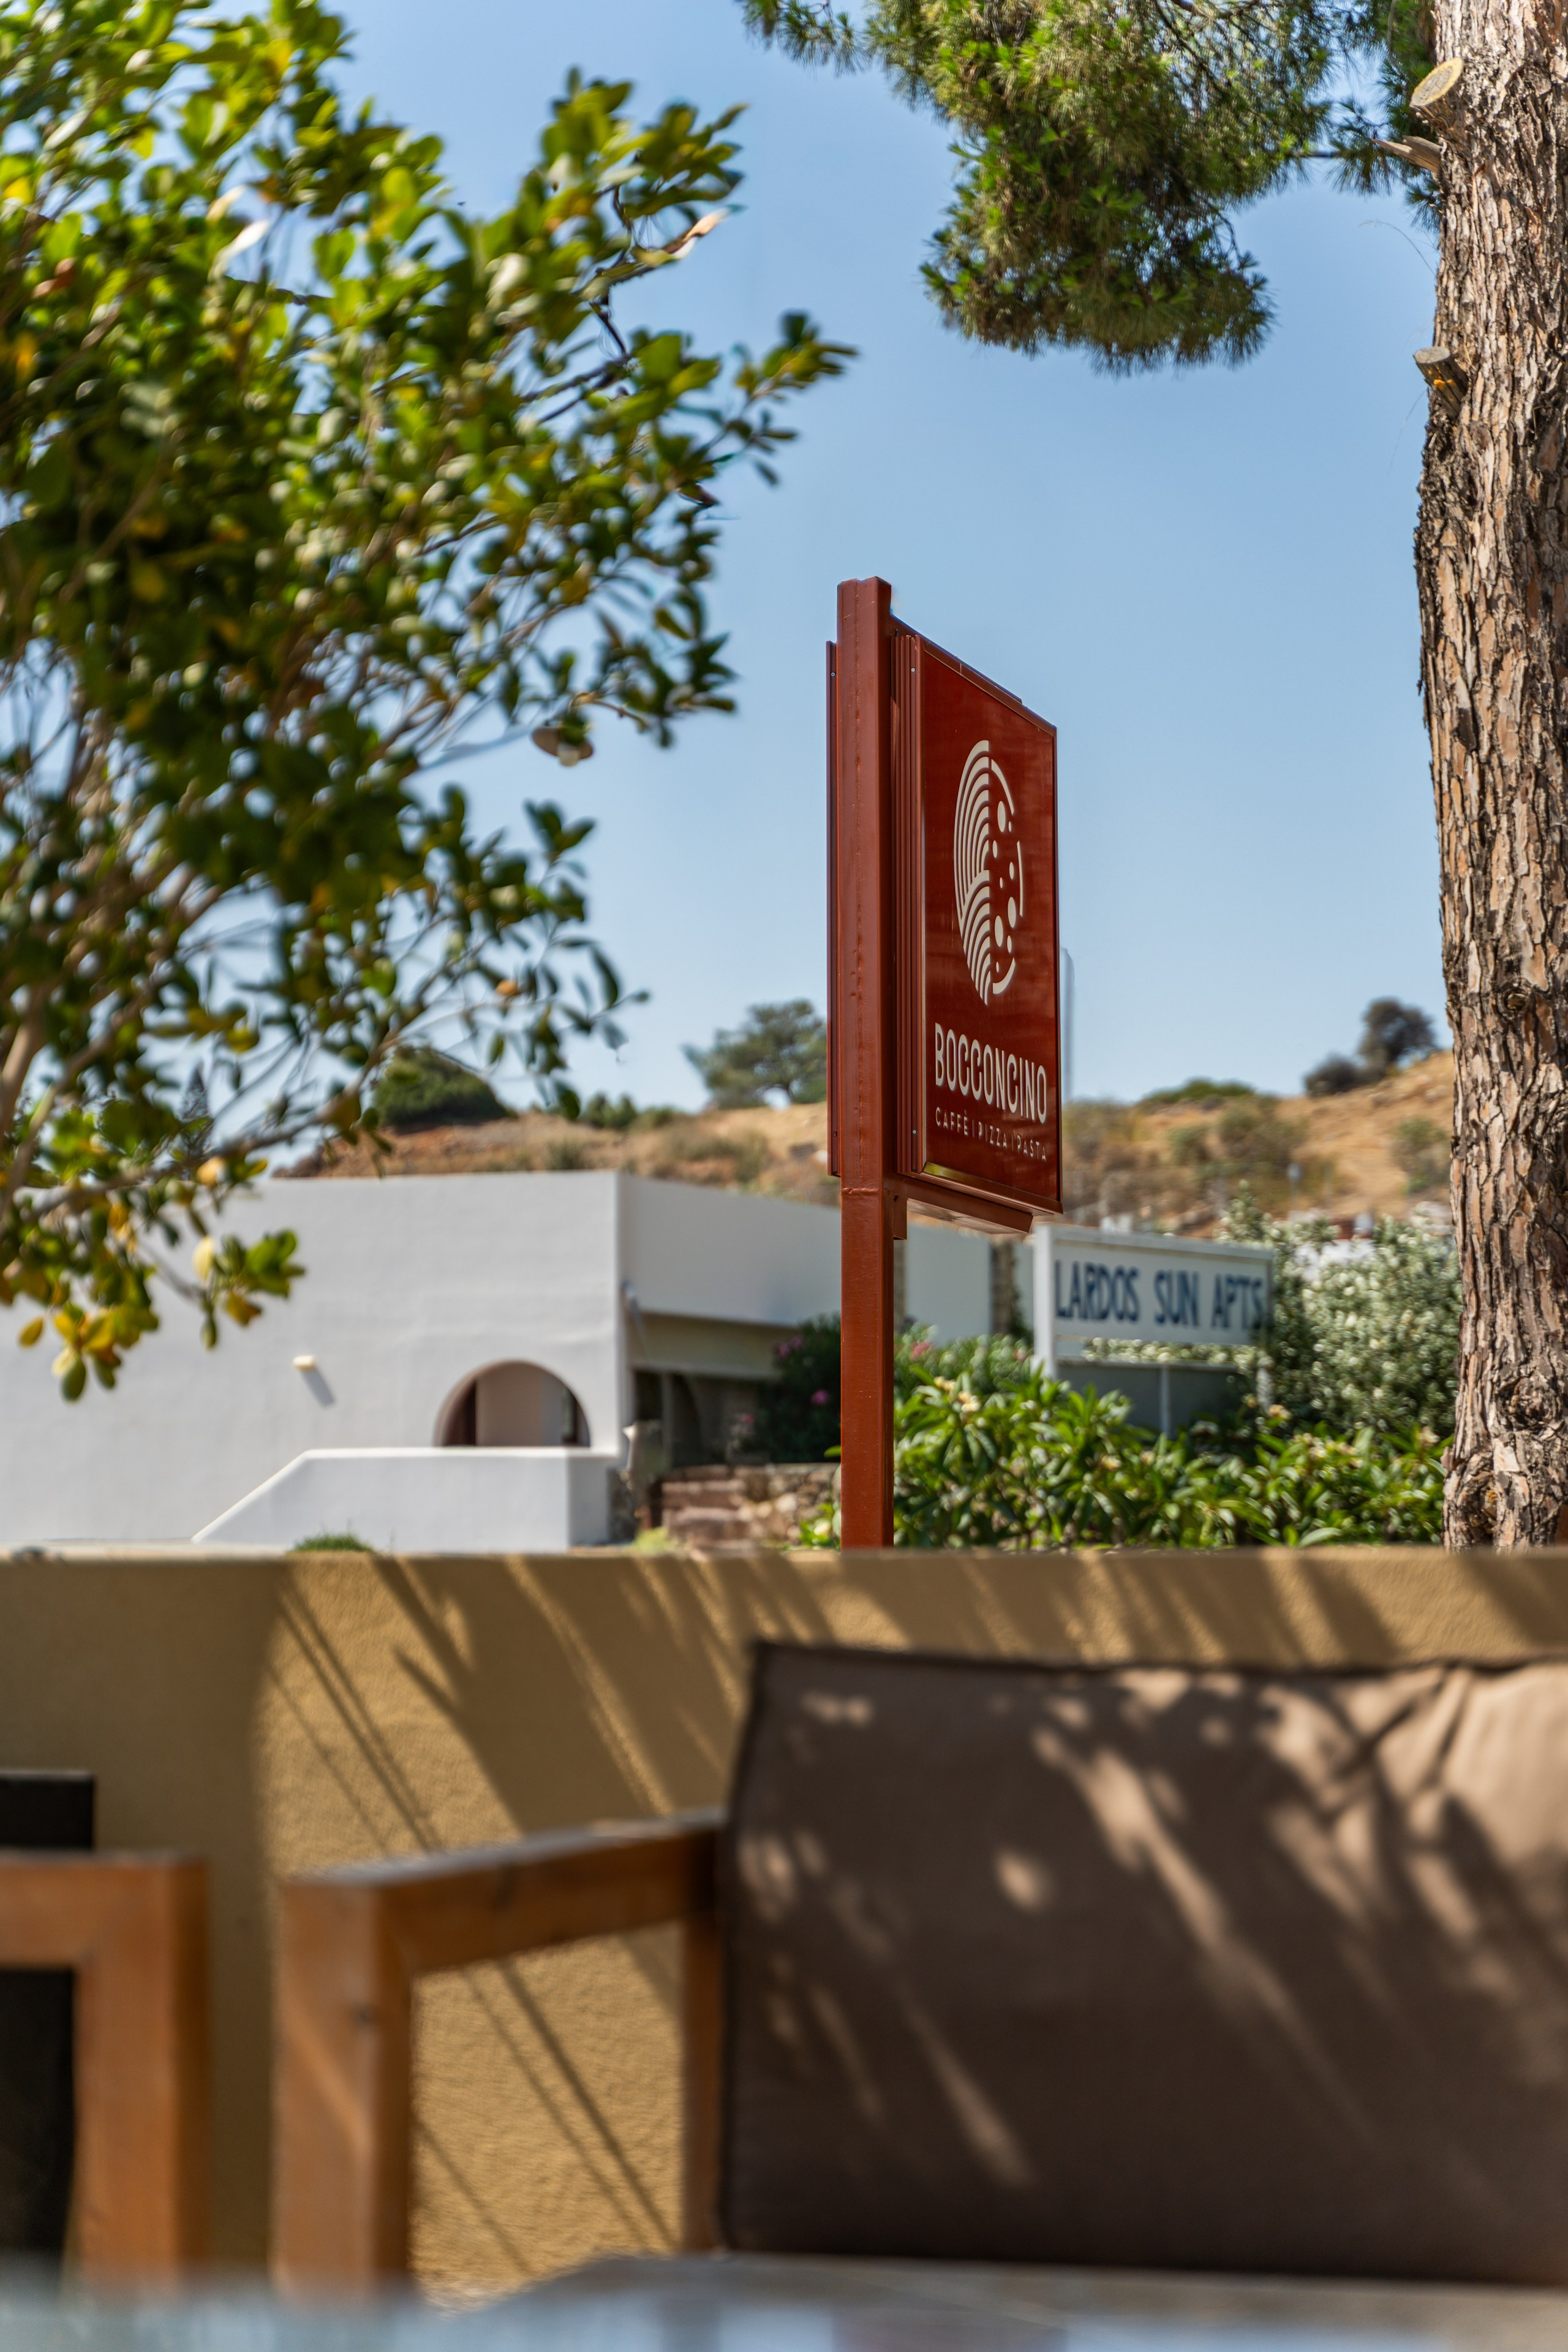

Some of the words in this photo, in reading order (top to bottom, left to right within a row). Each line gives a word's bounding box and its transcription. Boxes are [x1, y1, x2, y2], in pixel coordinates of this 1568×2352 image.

[935, 1022, 1047, 1123] BOCCONCINO
[935, 1106, 968, 1136] CAFFÈ
[978, 1121, 1008, 1149] PIZZA
[1017, 1134, 1046, 1161] PASTA
[1054, 1259, 1140, 1323] LARDOS
[1154, 1270, 1200, 1328] SUN
[1211, 1273, 1264, 1331] APTS
